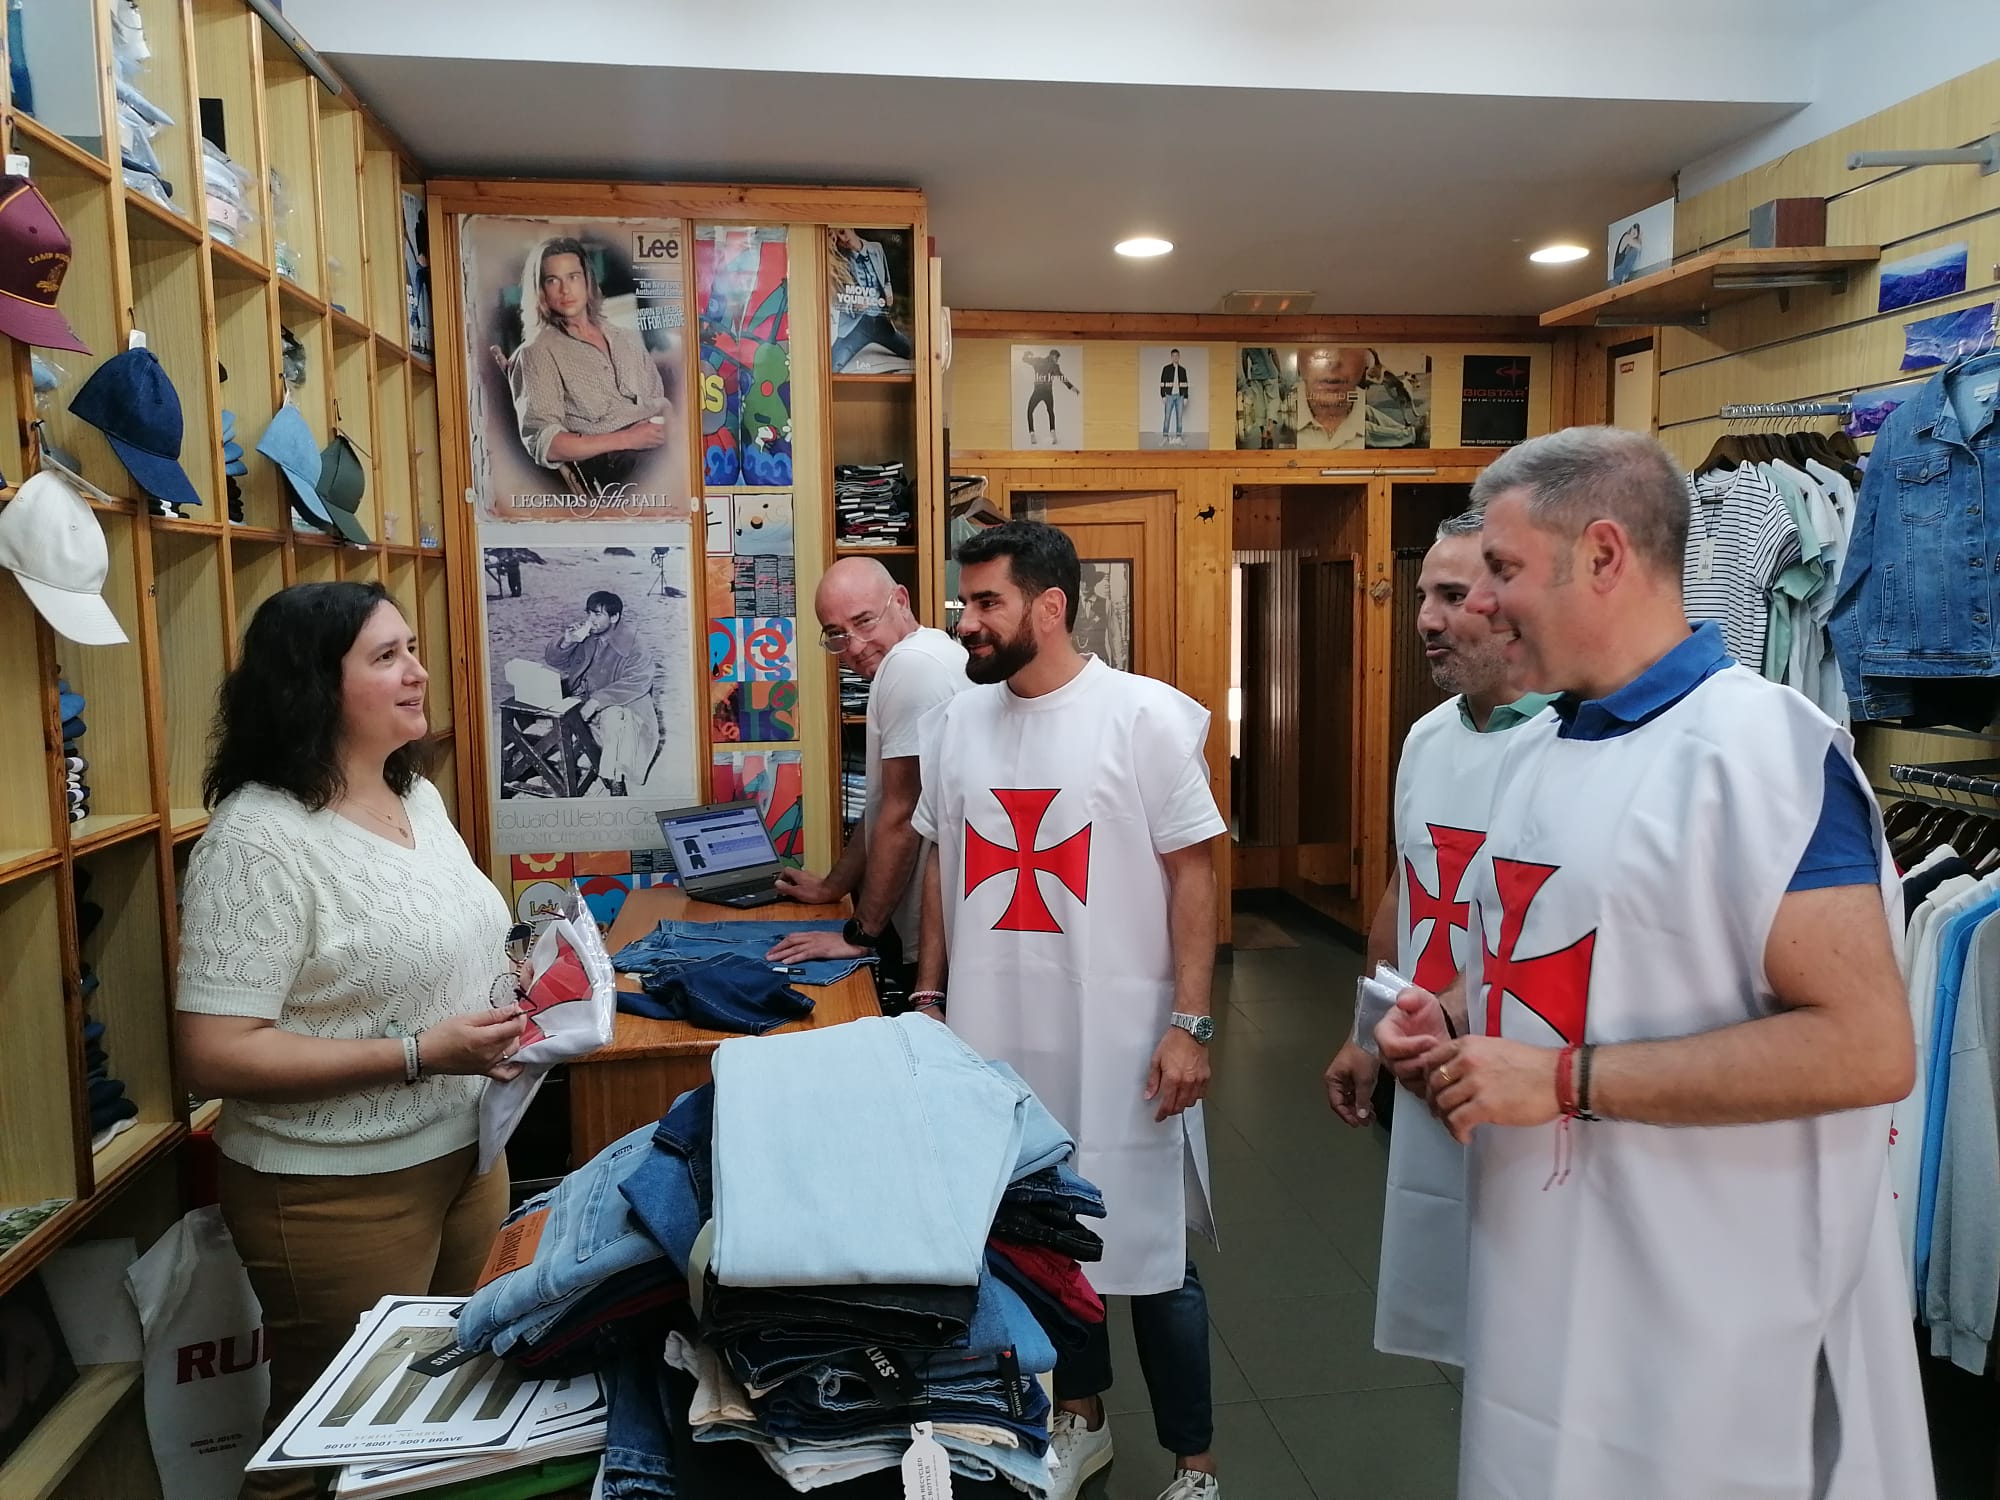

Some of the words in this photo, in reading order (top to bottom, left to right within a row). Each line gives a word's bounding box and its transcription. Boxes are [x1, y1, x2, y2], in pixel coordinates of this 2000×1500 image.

[637, 235, 679, 258] Lee
[1463, 388, 1525, 397] BIGSTAR
[511, 493, 587, 508] LEGENDS
[632, 493, 672, 508] FALL
[497, 808, 559, 830] Edward
[563, 808, 623, 828] Weston
[428, 1435, 464, 1443] BRAVE
[916, 1457, 926, 1494] RECYCLED
[924, 1465, 934, 1496] BOTTLES
